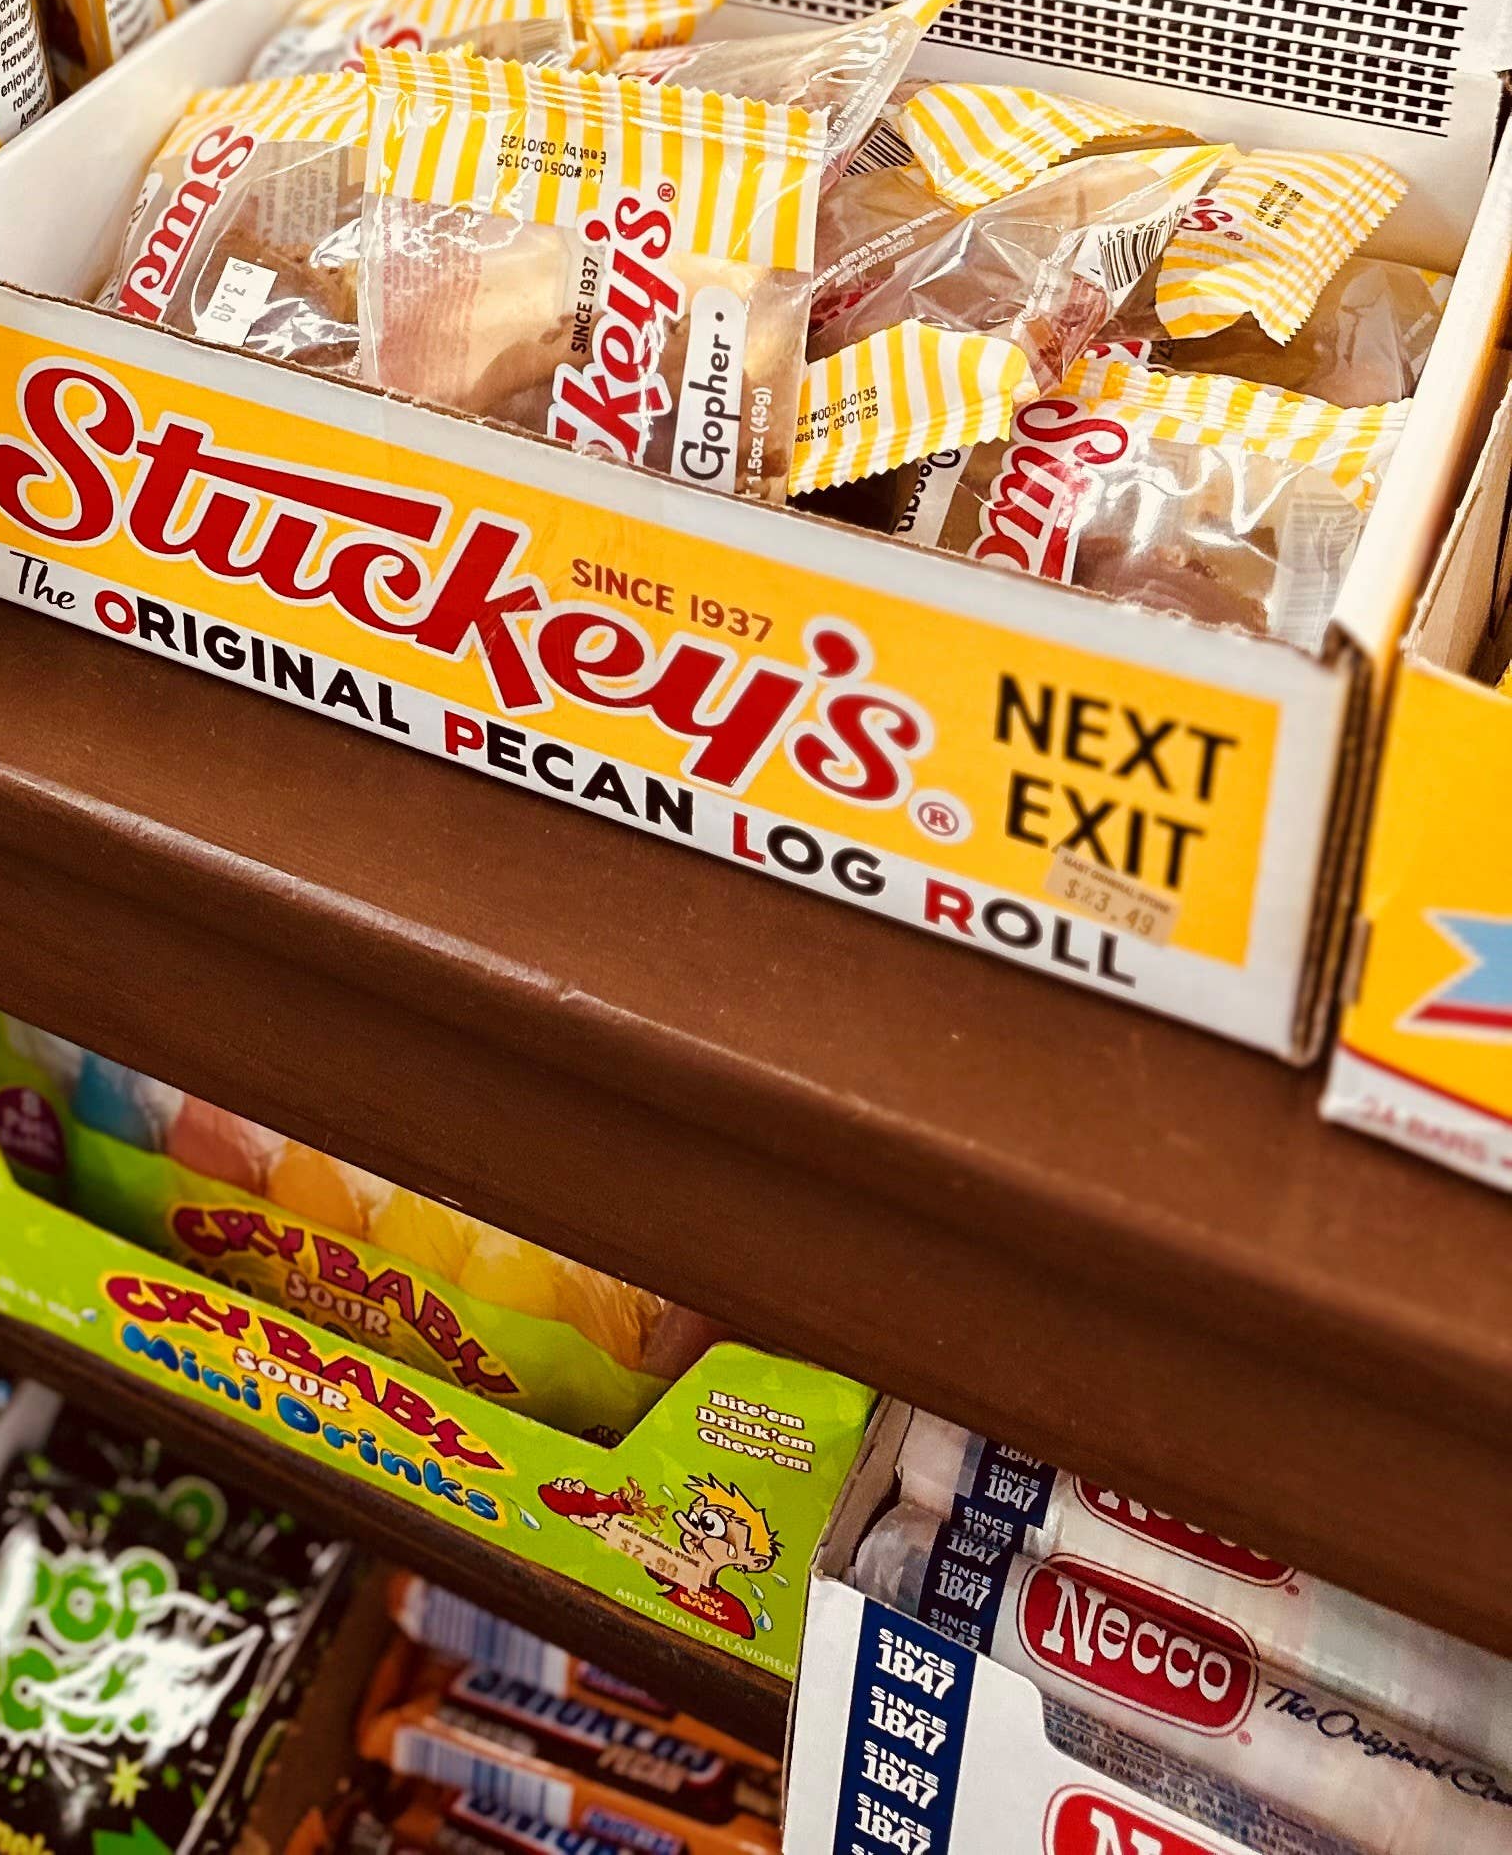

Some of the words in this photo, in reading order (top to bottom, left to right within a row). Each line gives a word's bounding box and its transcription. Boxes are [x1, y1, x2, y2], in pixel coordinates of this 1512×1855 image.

[582, 257, 601, 296] 1937
[570, 295, 595, 354] SINCE
[679, 341, 743, 482] Gopher
[749, 386, 773, 434] (43g)
[817, 425, 830, 439] by
[833, 403, 879, 431] 03/01/25
[571, 557, 675, 615] SINCE
[689, 594, 774, 643] 1937
[992, 671, 1241, 805] NEXT
[8, 551, 77, 612] The
[94, 589, 411, 735] ORIGINAL
[444, 712, 694, 837] PECAN
[731, 812, 887, 897] LOG
[923, 877, 1137, 989] ROLL
[1004, 768, 1205, 891] EXIT
[172, 1205, 304, 1265] CRY
[311, 1233, 520, 1396] BABY
[287, 1269, 391, 1339] SOUR
[105, 1275, 251, 1339] CRY
[264, 1319, 505, 1472] BABY
[233, 1345, 349, 1413] SOUR
[119, 1321, 263, 1412] Mini
[275, 1391, 500, 1521] Drinks
[696, 1405, 816, 1454] Drink'em
[709, 1390, 805, 1430] Bite'em
[697, 1427, 812, 1473] Chew'em
[990, 1463, 1040, 1490] SINCE
[985, 1474, 1039, 1513] 1847
[963, 1506, 1014, 1536] SINCE
[935, 1571, 991, 1611] 1847
[940, 1559, 993, 1587] SINCE
[615, 1588, 712, 1638] ARTIFICIALLY
[716, 1634, 795, 1676] FLAVORED
[930, 1608, 982, 1640] SINCE
[1041, 1574, 1233, 1704] Necco
[875, 1643, 955, 1701] 1847
[878, 1627, 957, 1677] SINCE
[867, 1699, 947, 1757] 1847
[870, 1685, 948, 1734] SINCE
[1264, 1680, 1317, 1722] The
[1317, 1709, 1453, 1779] Original
[860, 1754, 939, 1810] 1847
[863, 1740, 940, 1789] SINCE
[854, 1806, 931, 1854] 1847
[857, 1792, 933, 1842] SINCE
